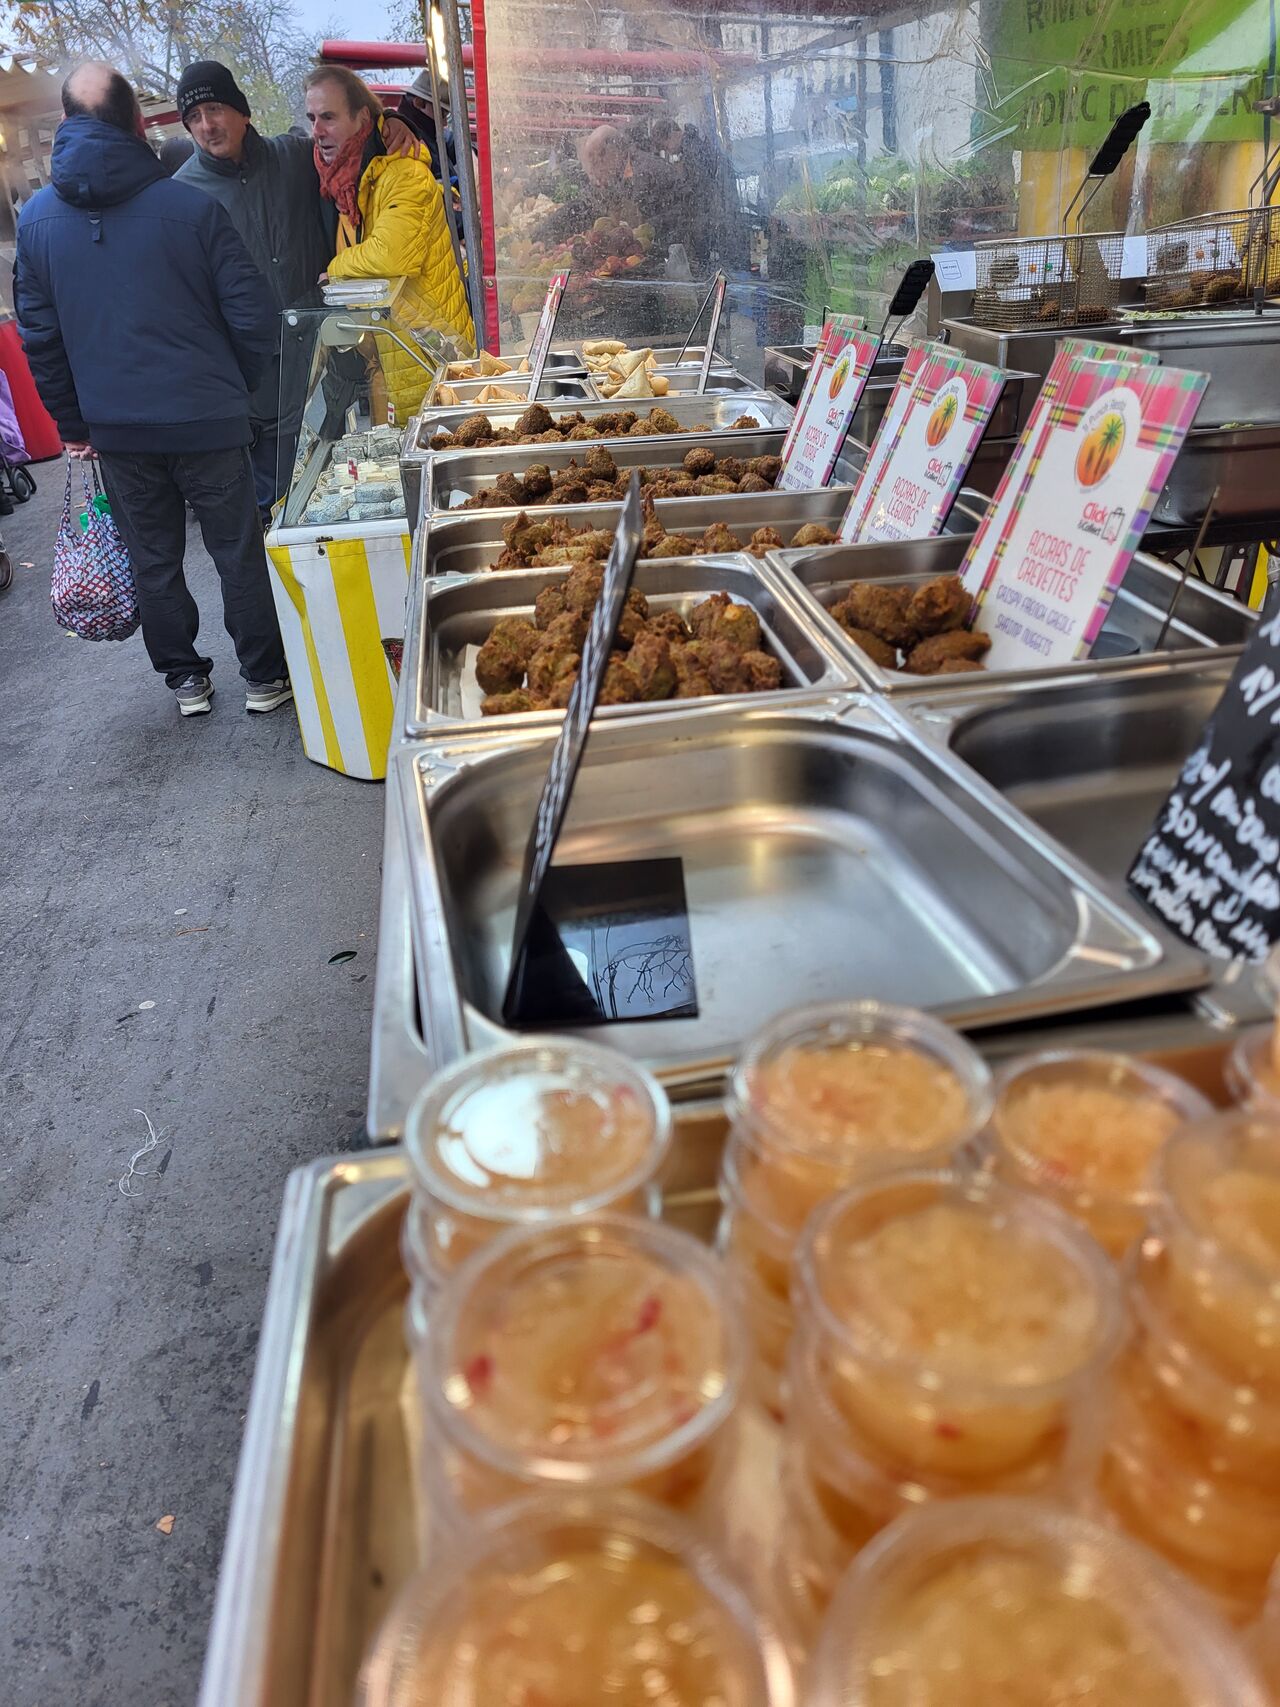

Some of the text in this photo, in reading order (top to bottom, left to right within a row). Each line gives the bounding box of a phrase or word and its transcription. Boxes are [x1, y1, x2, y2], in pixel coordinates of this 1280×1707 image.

[928, 458, 943, 474] Click
[892, 476, 931, 509] ACCRAS DE
[1083, 501, 1108, 525] Click
[1026, 530, 1092, 575] ACCRAS DE
[1017, 557, 1078, 602] CREVETTES
[996, 584, 1077, 636] CRISPY FRENCH CREOLE
[995, 614, 1054, 657] SHRIMP NUGGETS
